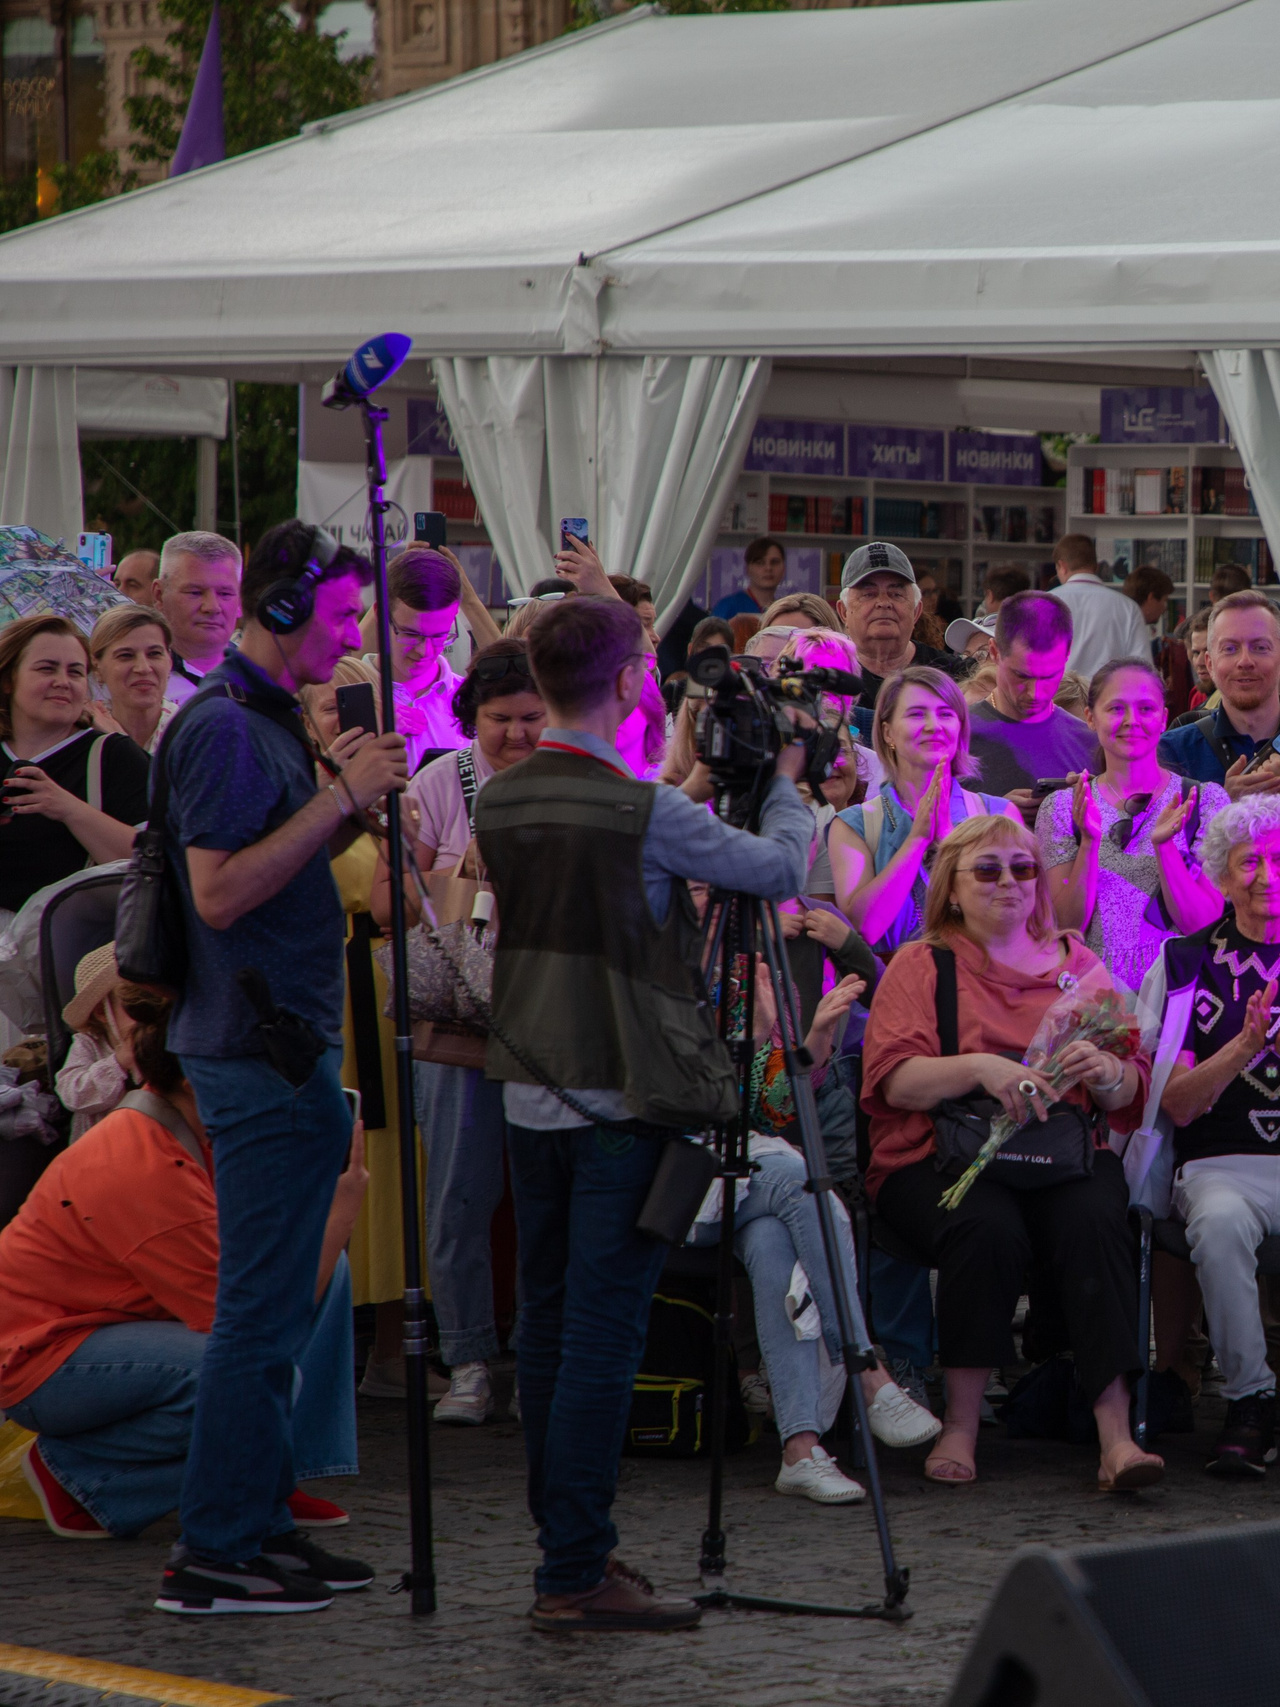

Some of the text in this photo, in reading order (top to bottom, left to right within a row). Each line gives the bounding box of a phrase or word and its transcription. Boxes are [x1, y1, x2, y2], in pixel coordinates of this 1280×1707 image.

[752, 437, 836, 460] НОВИНКИ
[872, 444, 922, 466] ХИТЫ
[956, 449, 1034, 470] НОВИНКИ
[996, 1152, 1053, 1165] BIMBA Y LOLA
